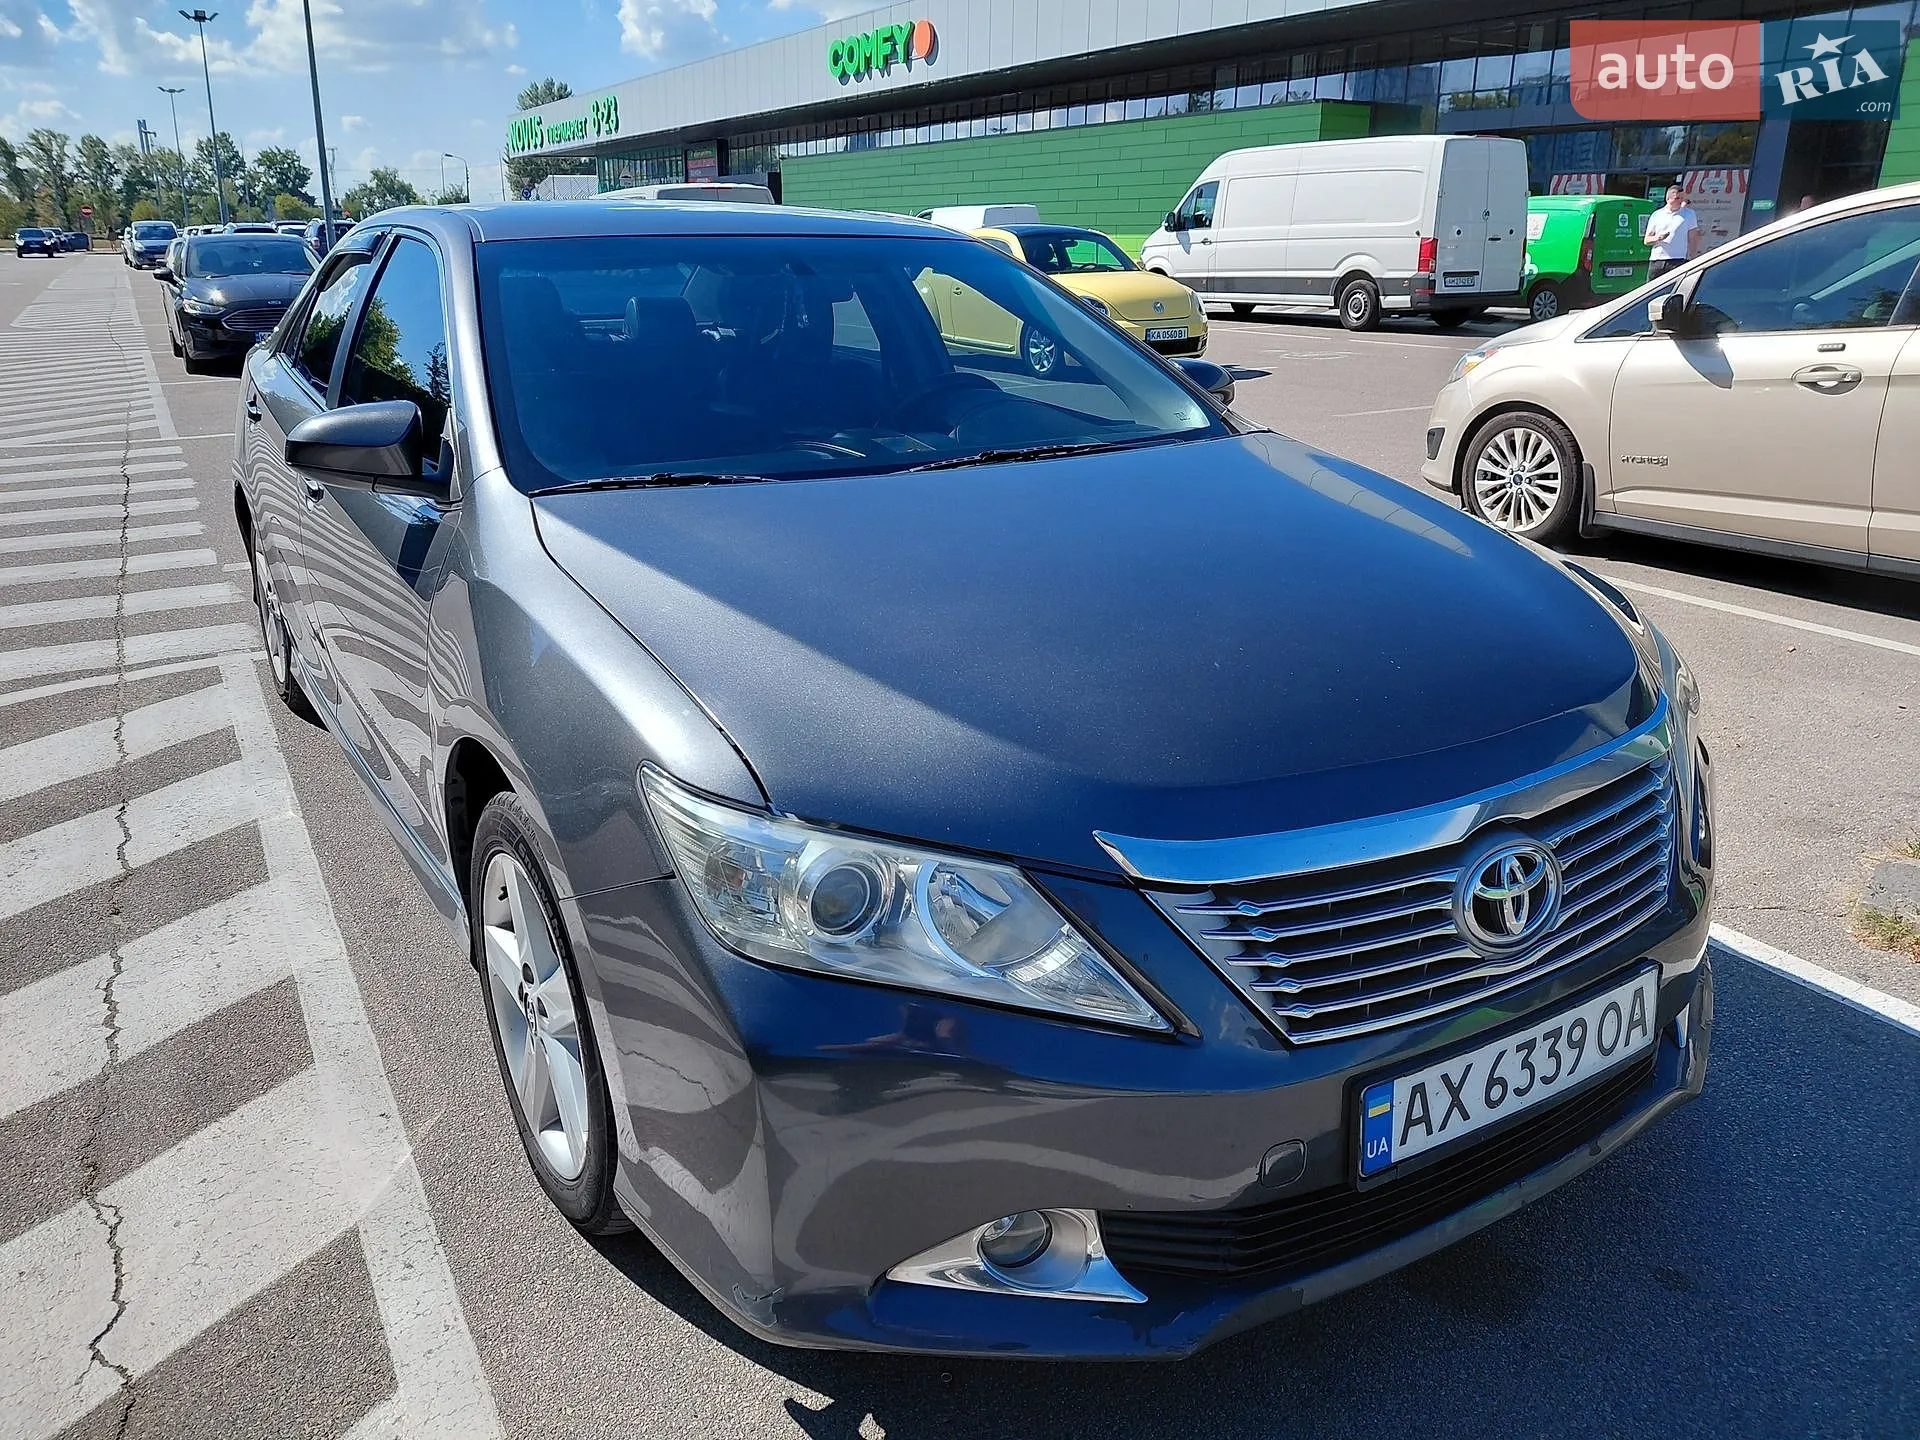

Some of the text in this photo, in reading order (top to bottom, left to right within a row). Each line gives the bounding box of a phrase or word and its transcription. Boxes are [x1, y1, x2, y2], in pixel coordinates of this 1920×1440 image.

[828, 20, 915, 78] COMFY
[510, 115, 544, 152] NOVUS
[1151, 329, 1187, 340] KA 0560 BI
[1399, 986, 1648, 1147] AX 6339 OA
[1367, 1136, 1389, 1159] UA
